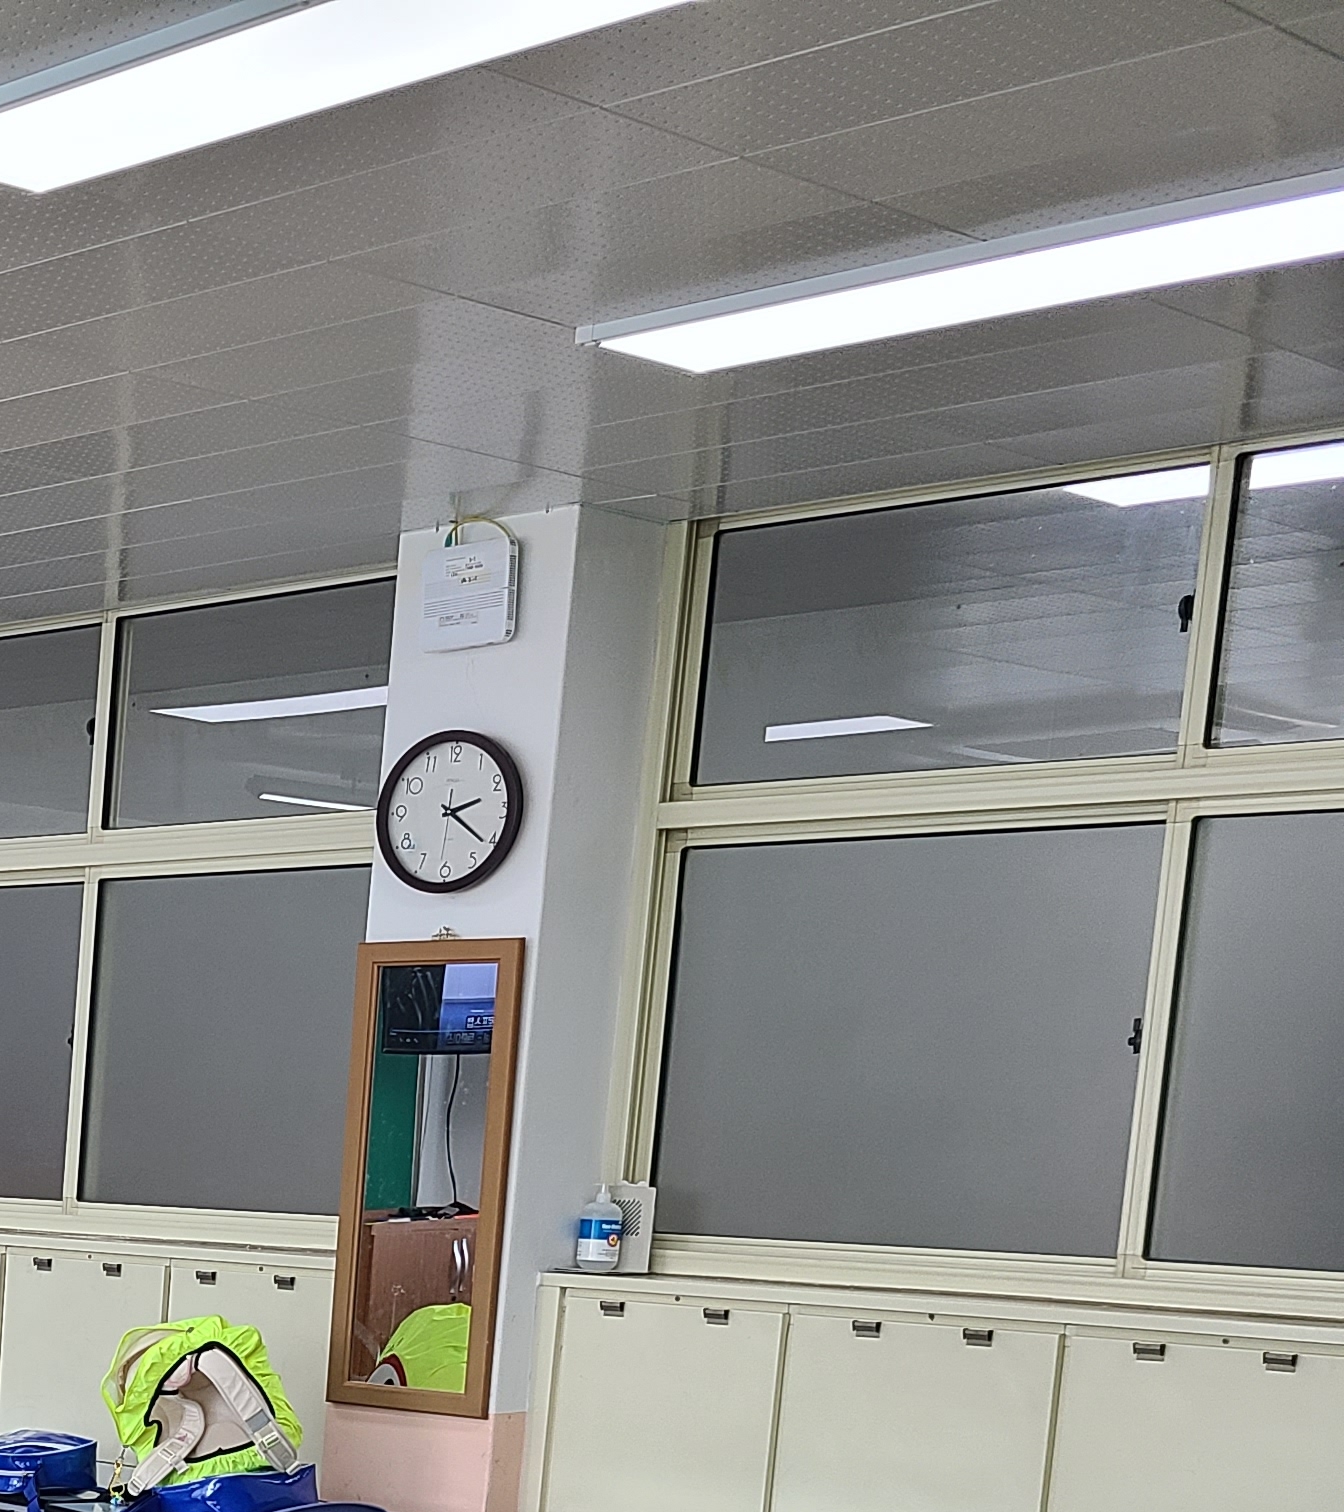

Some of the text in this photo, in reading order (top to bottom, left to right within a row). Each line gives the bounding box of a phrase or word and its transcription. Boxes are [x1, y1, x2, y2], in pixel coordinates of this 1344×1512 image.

[450, 745, 463, 763] 12
[479, 753, 484, 771] 1
[425, 755, 437, 773] 11
[405, 776, 424, 795] 10
[492, 773, 502, 792] 2
[395, 804, 408, 823] 9
[498, 801, 508, 819] 3
[400, 832, 412, 850] 8
[488, 831, 498, 848] 4
[419, 852, 428, 870] 7
[439, 860, 452, 879] 6
[467, 851, 478, 870] 5
